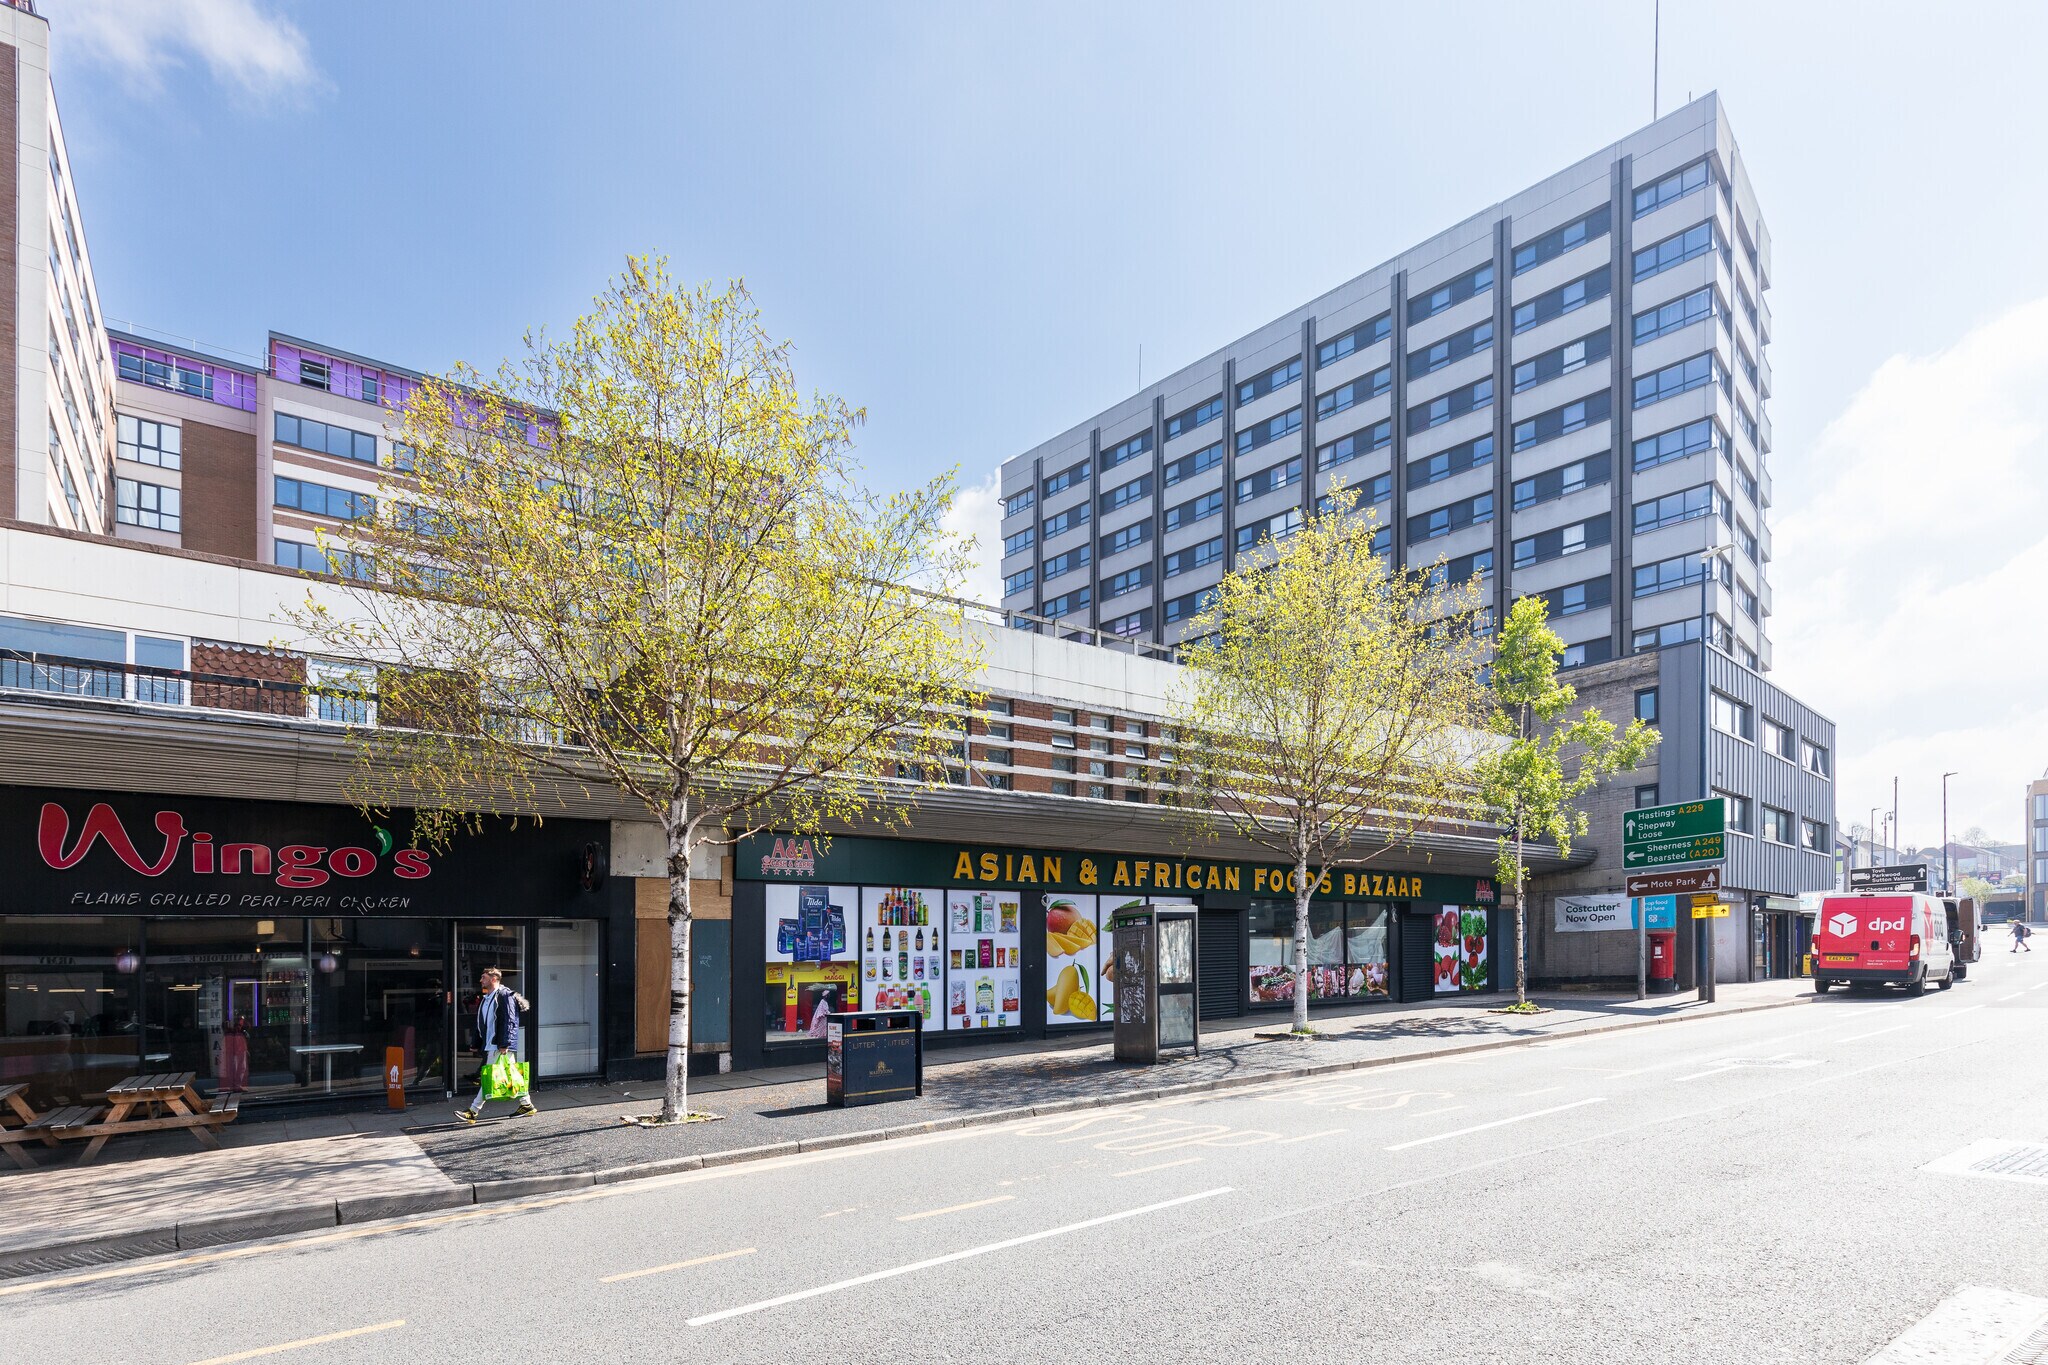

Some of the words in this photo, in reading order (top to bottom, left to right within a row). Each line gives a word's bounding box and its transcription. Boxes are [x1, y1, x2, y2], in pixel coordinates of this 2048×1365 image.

[1638, 809, 1675, 820] Hastings
[1678, 803, 1704, 814] A229
[1638, 820, 1676, 831] Shepway
[1638, 831, 1663, 839] Loose
[38, 802, 431, 888] Wingo's
[1647, 841, 1691, 852] Sheerness
[1694, 836, 1721, 846] A249
[1647, 852, 1686, 862] Bearsted
[1689, 847, 1720, 858] (A20)
[953, 851, 1063, 884] ASIAN
[1080, 858, 1098, 886] &
[1113, 860, 1241, 892] AFRICAN
[1254, 867, 1333, 895] FOODS
[1343, 873, 1423, 898] BAZAAR
[1650, 880, 1673, 888] Mote
[1676, 878, 1697, 886] Park
[71, 892, 141, 904] FLAME
[149, 892, 231, 906] GRILLED
[239, 894, 331, 908] PERI-PERI
[1566, 903, 1617, 913] Costcutter
[1566, 914, 1587, 923] Now
[1589, 914, 1616, 924] Open
[1868, 917, 1905, 934] dpd
[853, 1041, 876, 1050] LITTER
